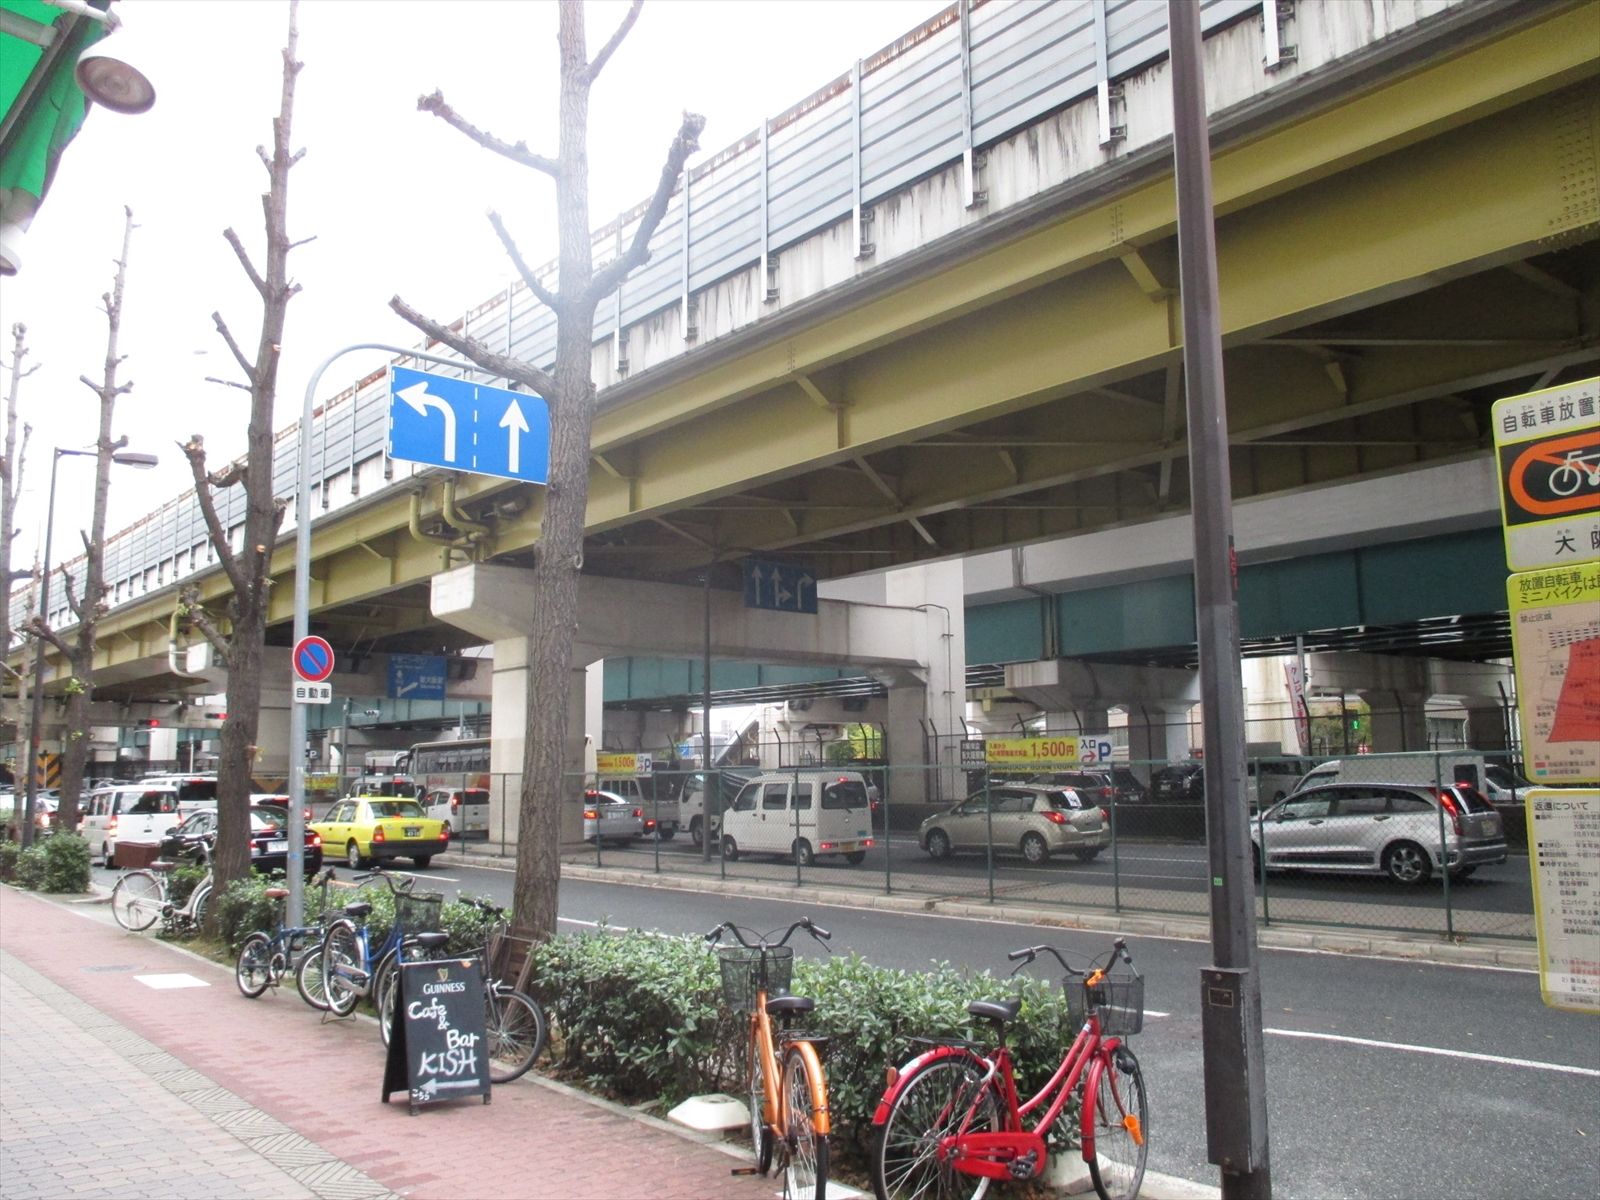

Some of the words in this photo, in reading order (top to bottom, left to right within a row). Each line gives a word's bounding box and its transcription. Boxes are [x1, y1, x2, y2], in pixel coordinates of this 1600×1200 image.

[1503, 397, 1600, 433] 自転車放置
[1519, 572, 1582, 592] 放置自転車
[1520, 586, 1583, 603] ミニバイク
[297, 687, 330, 699] 自動車
[1032, 741, 1074, 758] 1,500円
[1081, 739, 1096, 749] 入口
[1098, 742, 1111, 761] P
[644, 758, 651, 771] P
[423, 982, 466, 994] GUINNESS
[408, 997, 447, 1020] Cafe
[437, 1016, 449, 1030] &
[446, 1029, 480, 1049] Bar
[417, 1049, 477, 1076] KISH
